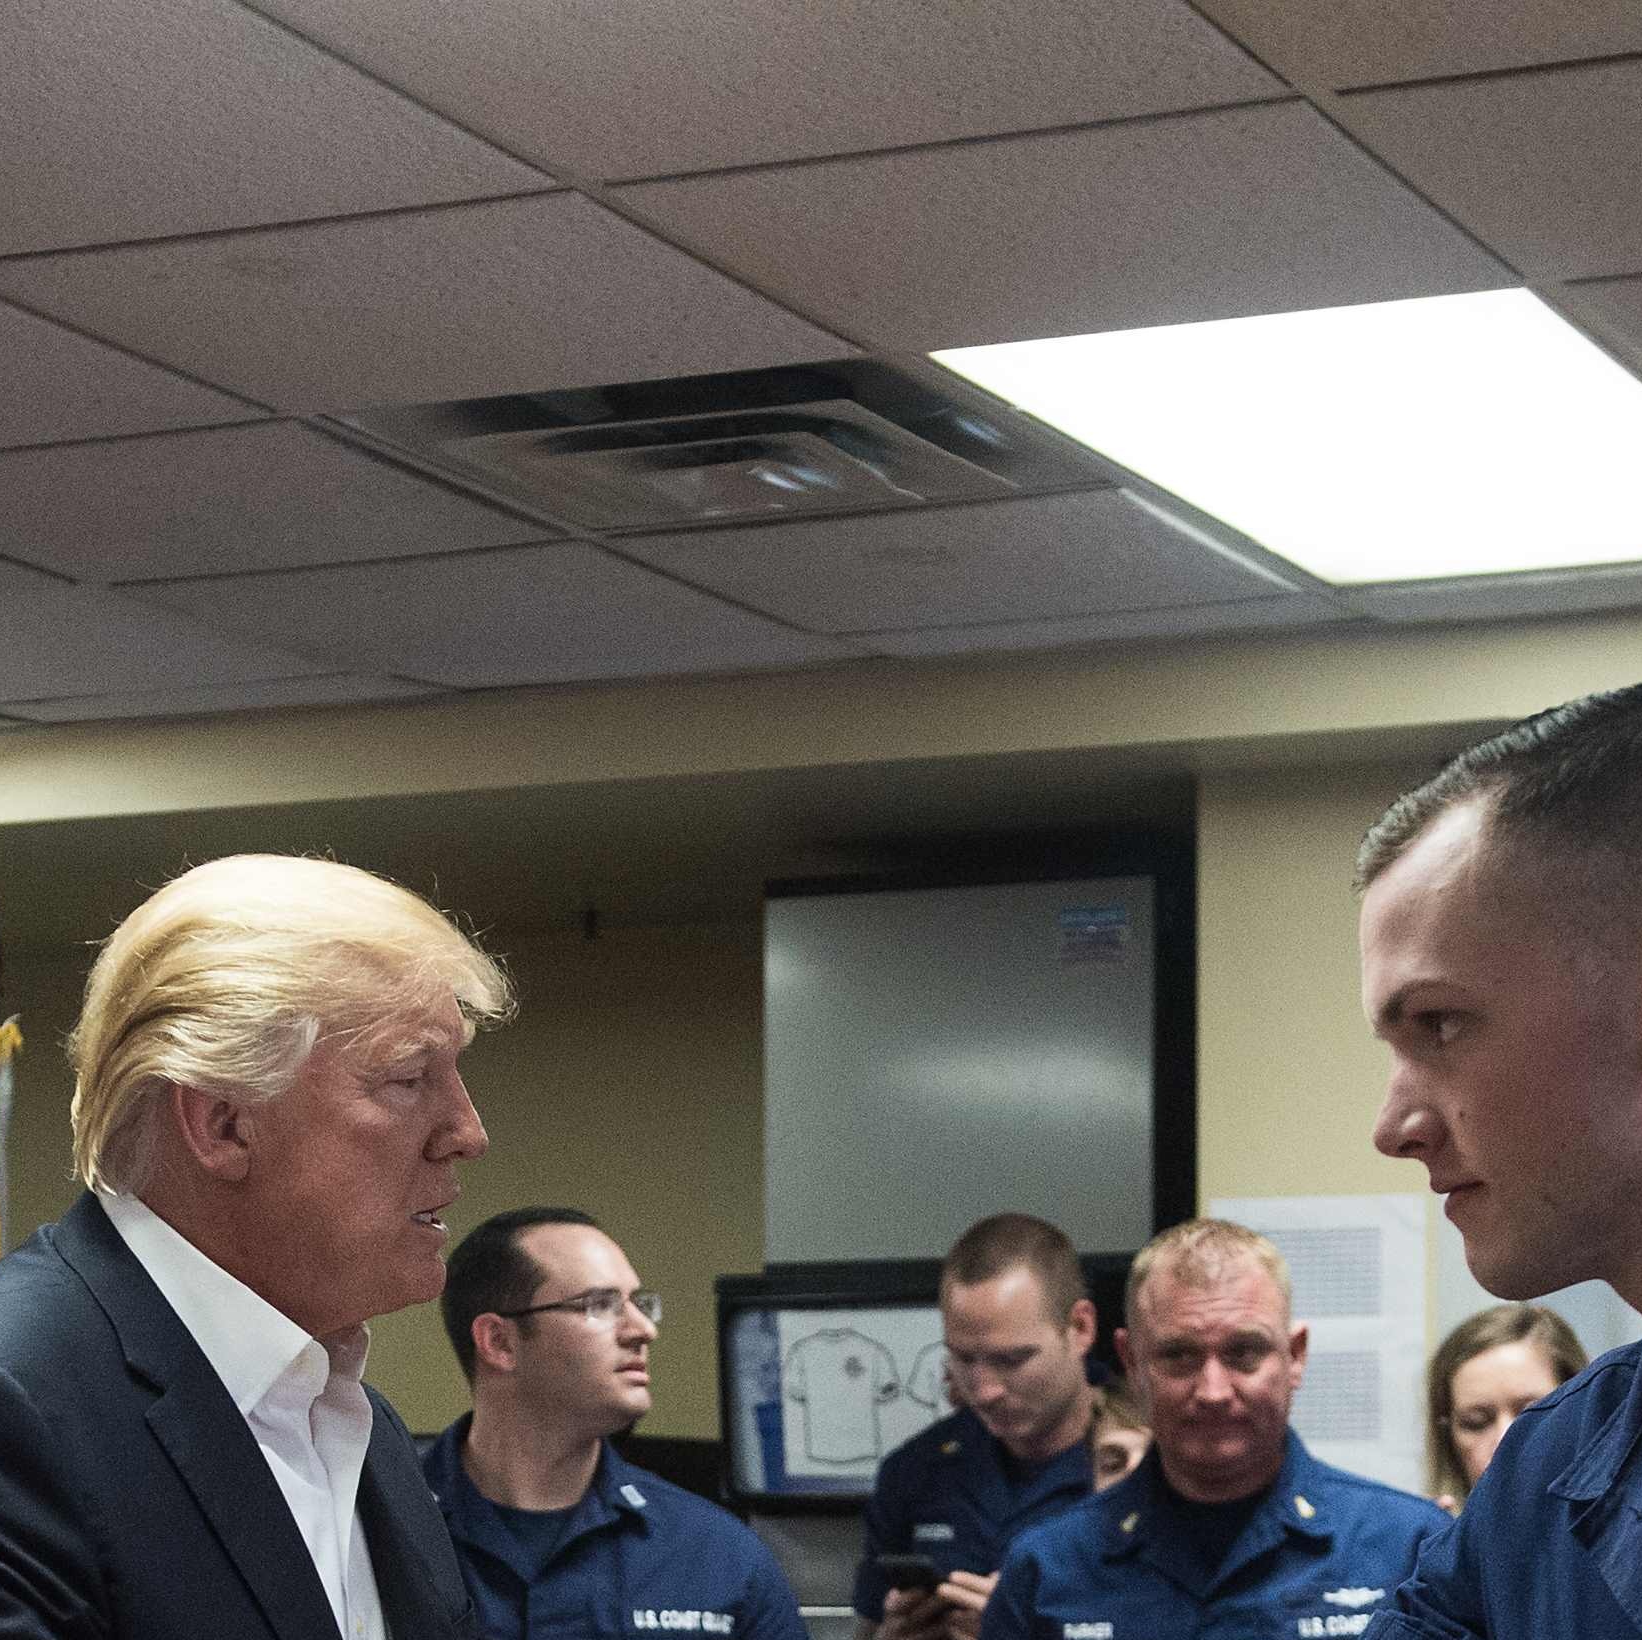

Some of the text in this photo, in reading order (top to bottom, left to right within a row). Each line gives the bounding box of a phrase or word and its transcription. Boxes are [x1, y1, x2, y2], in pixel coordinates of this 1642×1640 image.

[633, 1609, 659, 1630] U.S.
[659, 1609, 701, 1631] COAST
[1298, 1616, 1325, 1638] U.S.
